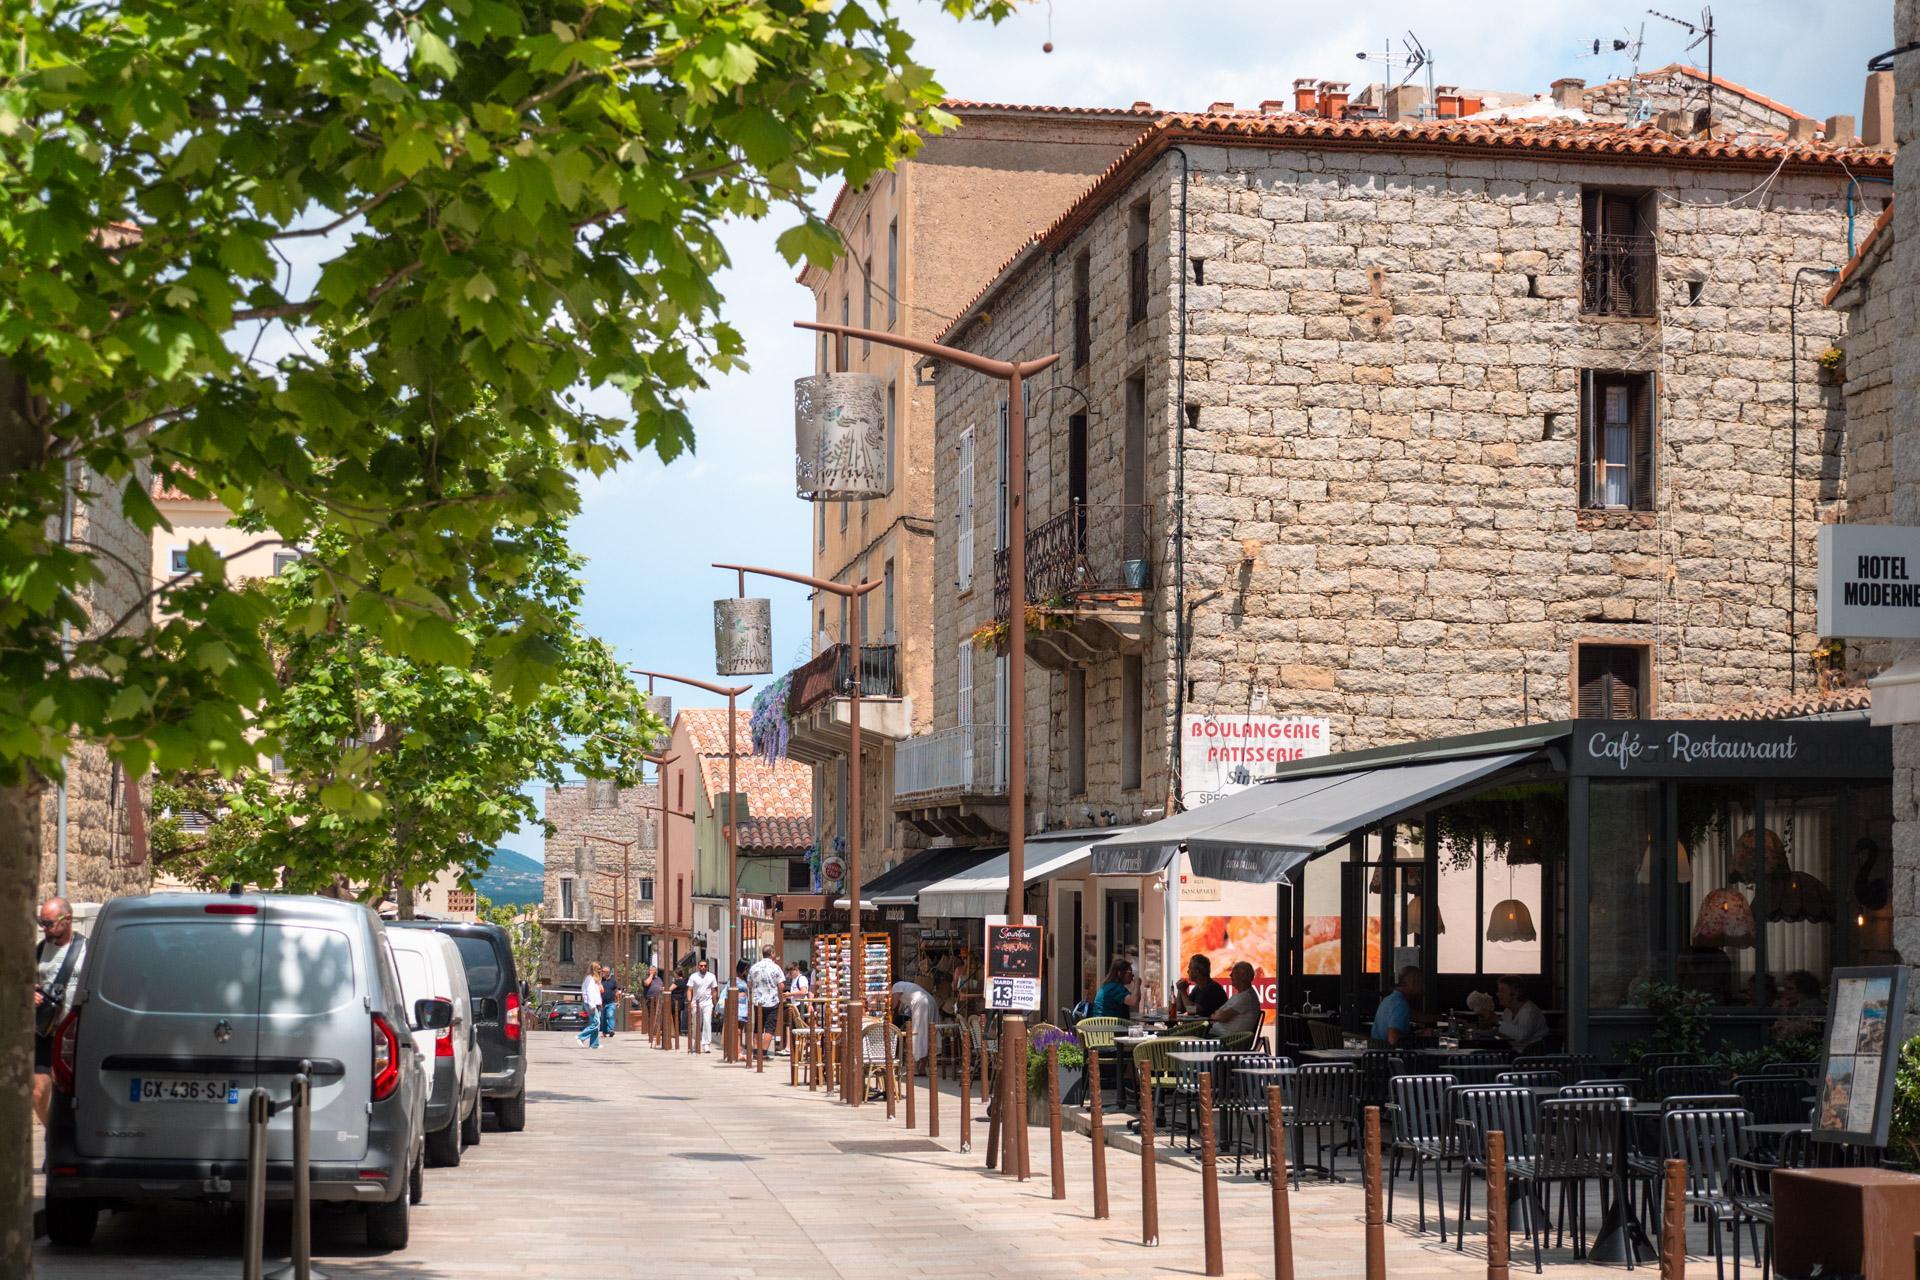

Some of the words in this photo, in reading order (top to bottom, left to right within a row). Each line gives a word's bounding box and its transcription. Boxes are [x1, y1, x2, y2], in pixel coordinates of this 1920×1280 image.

[1858, 555, 1909, 580] HOTEL
[1844, 582, 1920, 608] MODERNE
[1191, 722, 1320, 739] BOULANGERIE
[1207, 747, 1304, 762] PATISSERIE
[1588, 731, 1643, 770] Café
[1667, 731, 1798, 763] Restaurant
[993, 986, 1012, 999] 13
